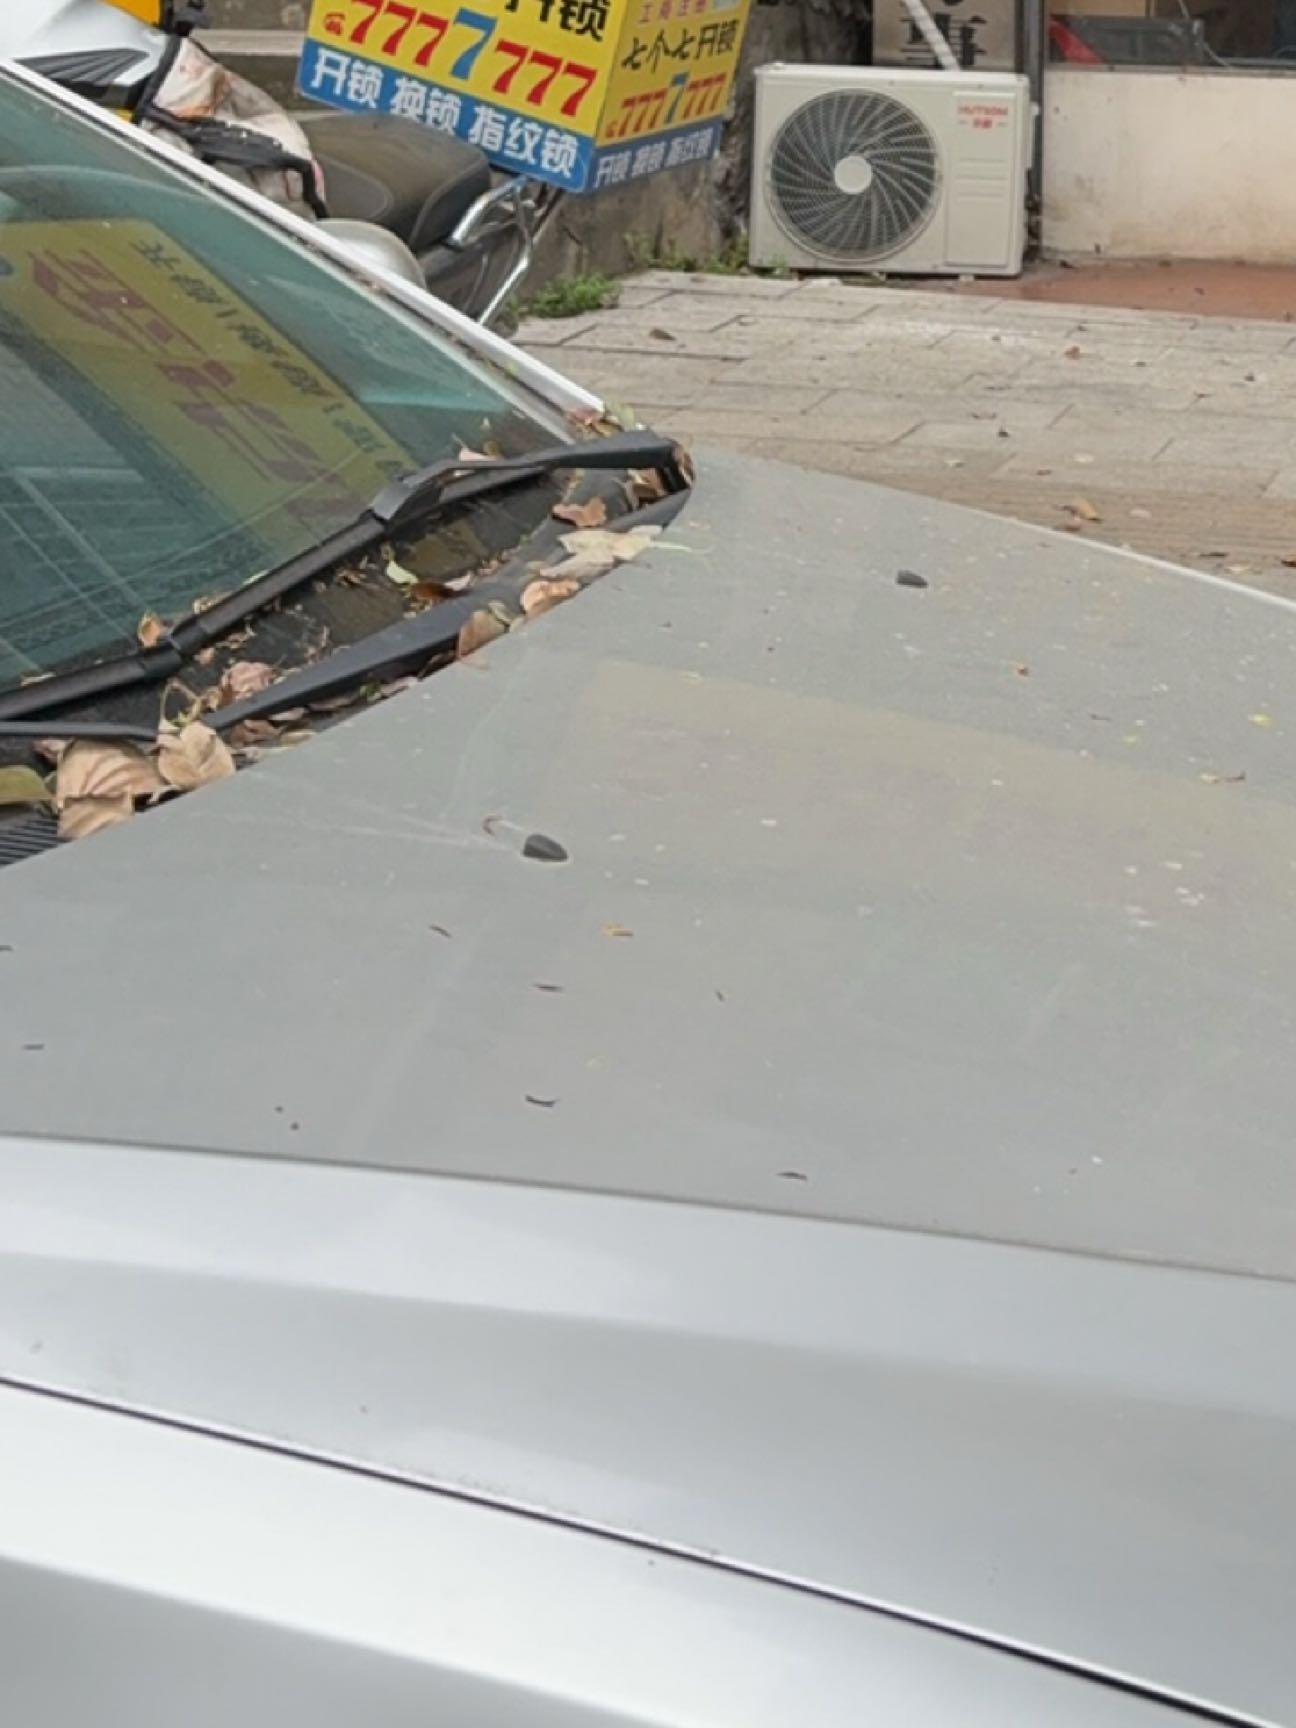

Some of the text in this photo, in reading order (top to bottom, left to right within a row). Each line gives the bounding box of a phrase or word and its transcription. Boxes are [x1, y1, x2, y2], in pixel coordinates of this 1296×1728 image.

[311, 47, 384, 109] 开锁
[468, 105, 579, 179] 指纹锁
